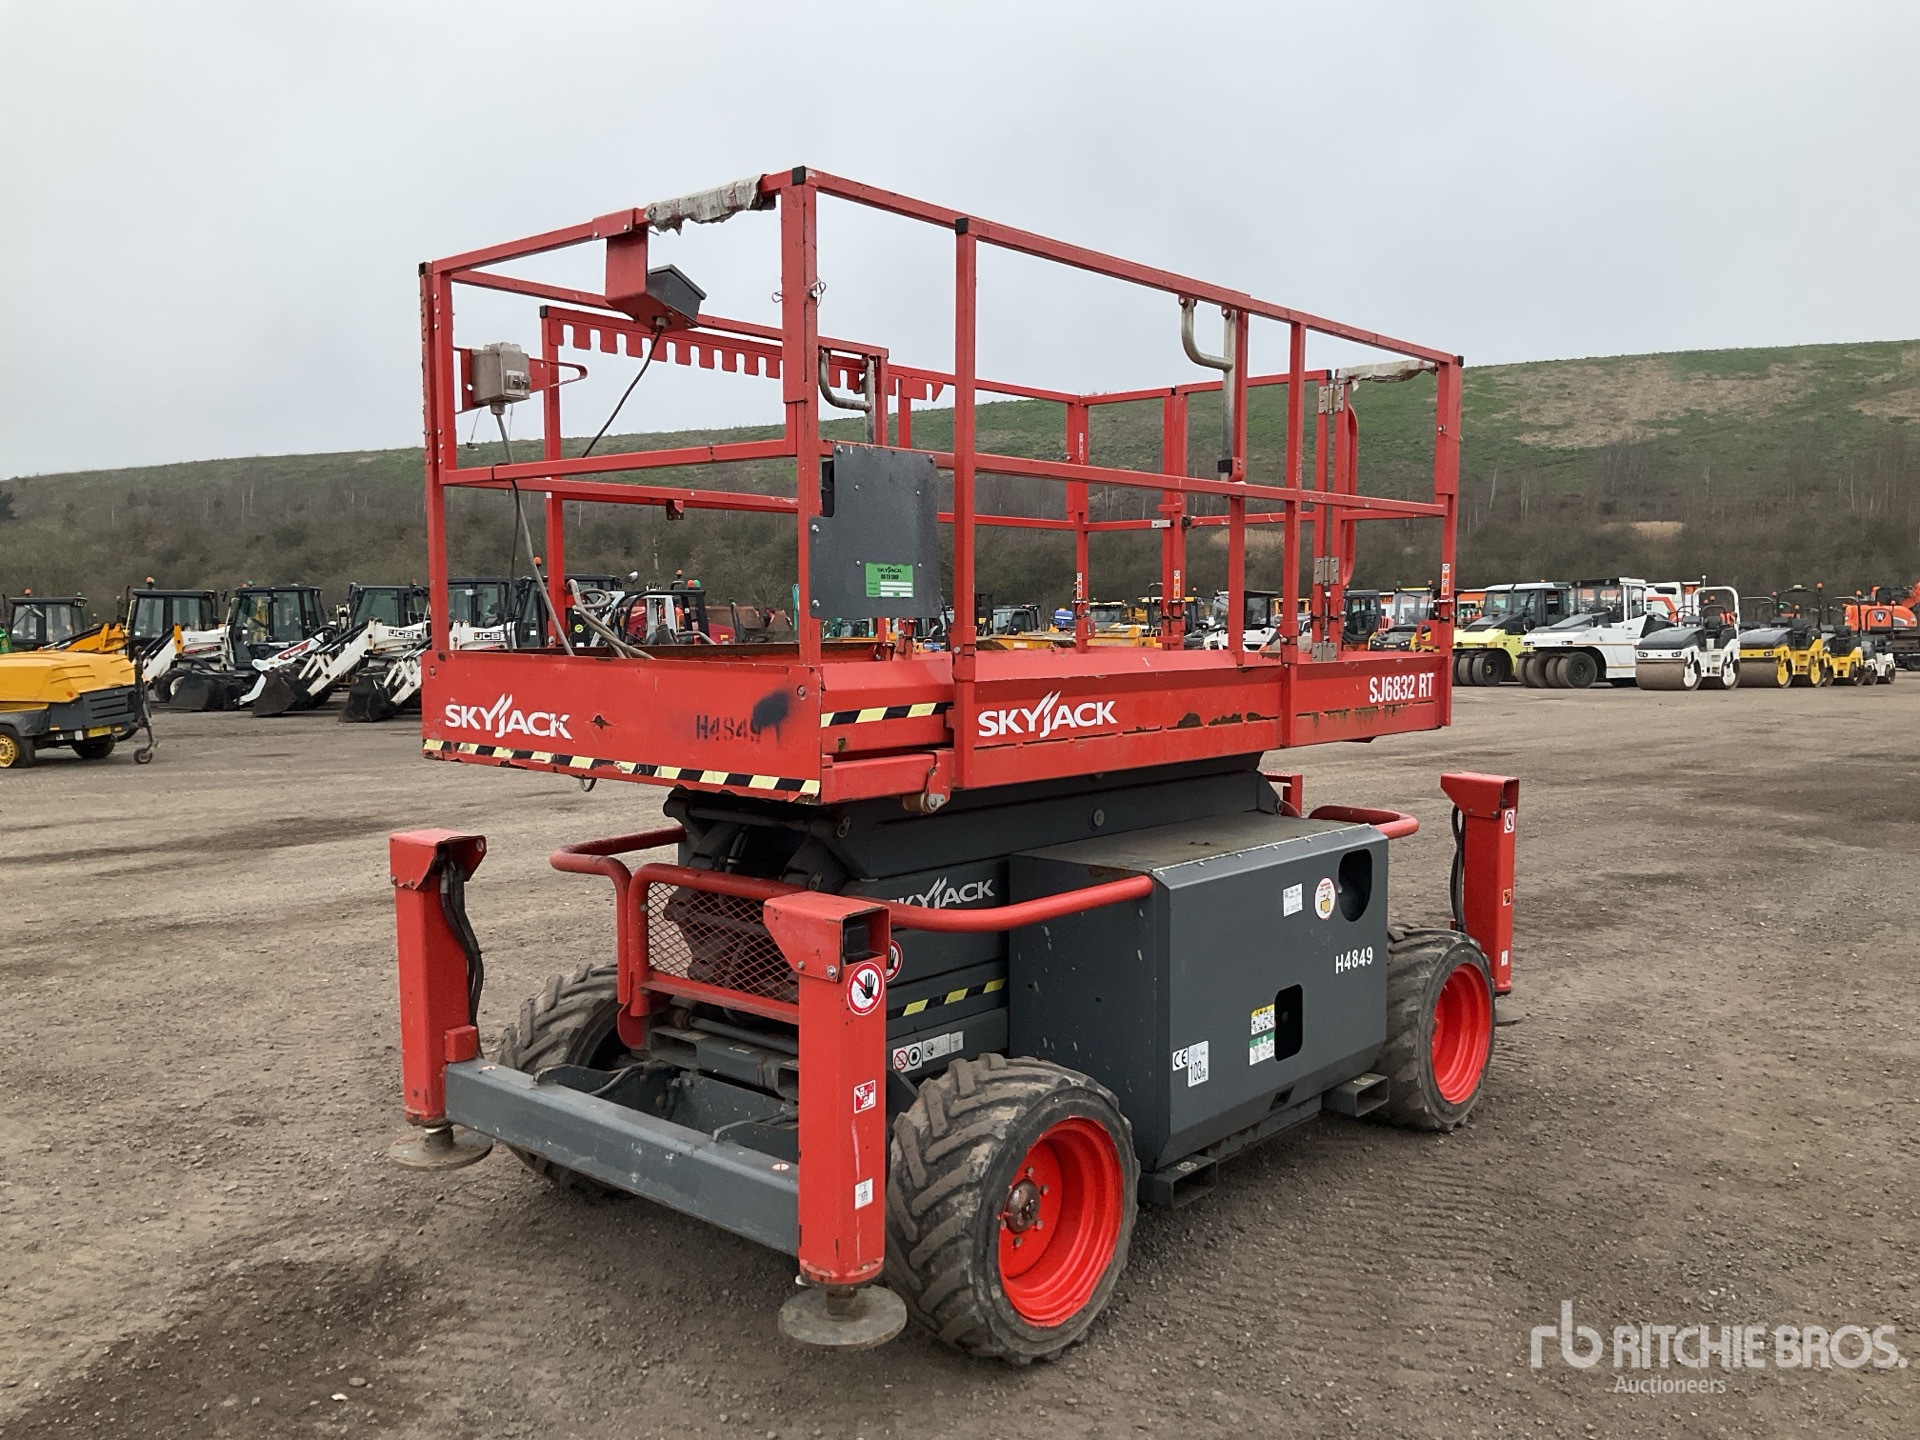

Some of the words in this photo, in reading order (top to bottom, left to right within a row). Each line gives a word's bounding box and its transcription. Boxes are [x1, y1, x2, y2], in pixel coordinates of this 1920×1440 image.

[389, 629, 414, 638] JCB
[474, 632, 500, 640] JCB
[1369, 674, 1415, 703] SJ6832
[1418, 672, 1434, 698] RT
[445, 693, 573, 740] SKYJACK
[977, 690, 1119, 738] SKYJACK
[889, 877, 995, 909] YJACK
[1335, 946, 1373, 974] H4849
[1190, 1060, 1202, 1082] 103
